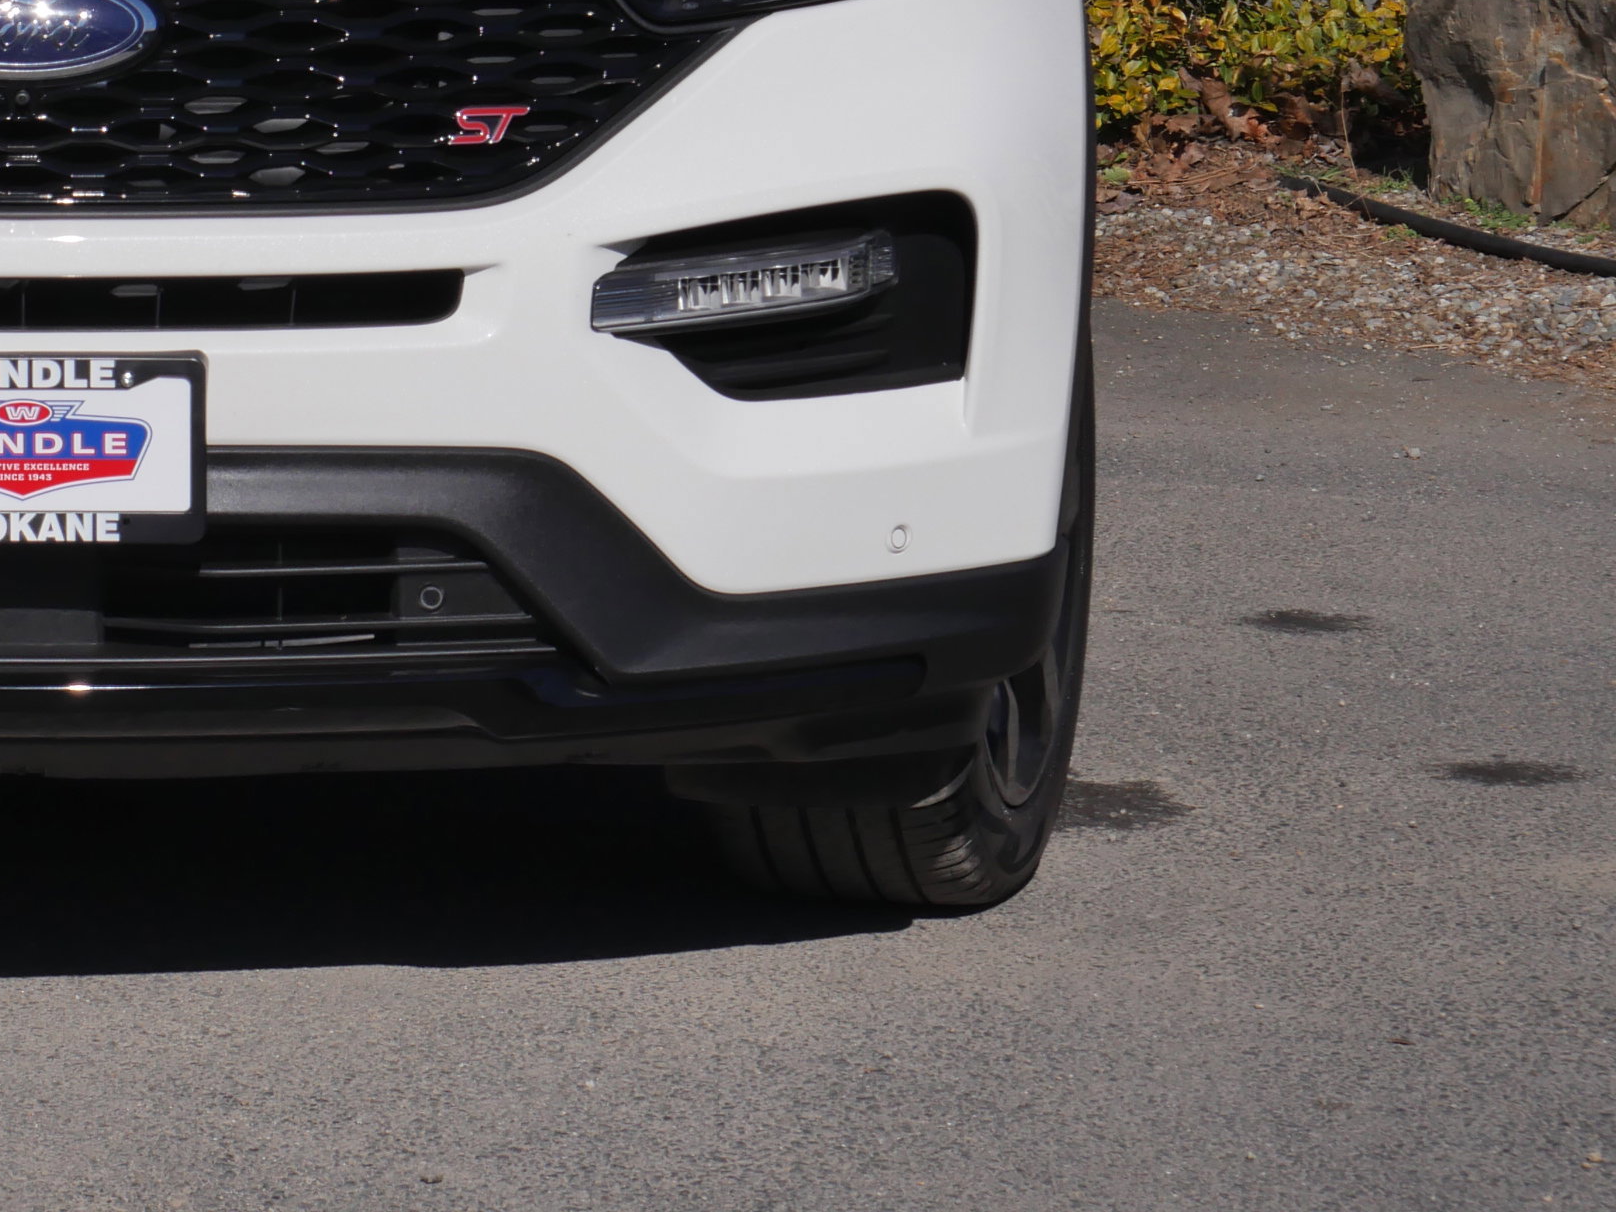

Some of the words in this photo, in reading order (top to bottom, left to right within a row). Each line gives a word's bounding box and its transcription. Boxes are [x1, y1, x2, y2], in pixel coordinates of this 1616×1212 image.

[447, 106, 531, 145] ST
[23, 463, 90, 471] EXCELLENCE
[27, 473, 53, 481] 1943
